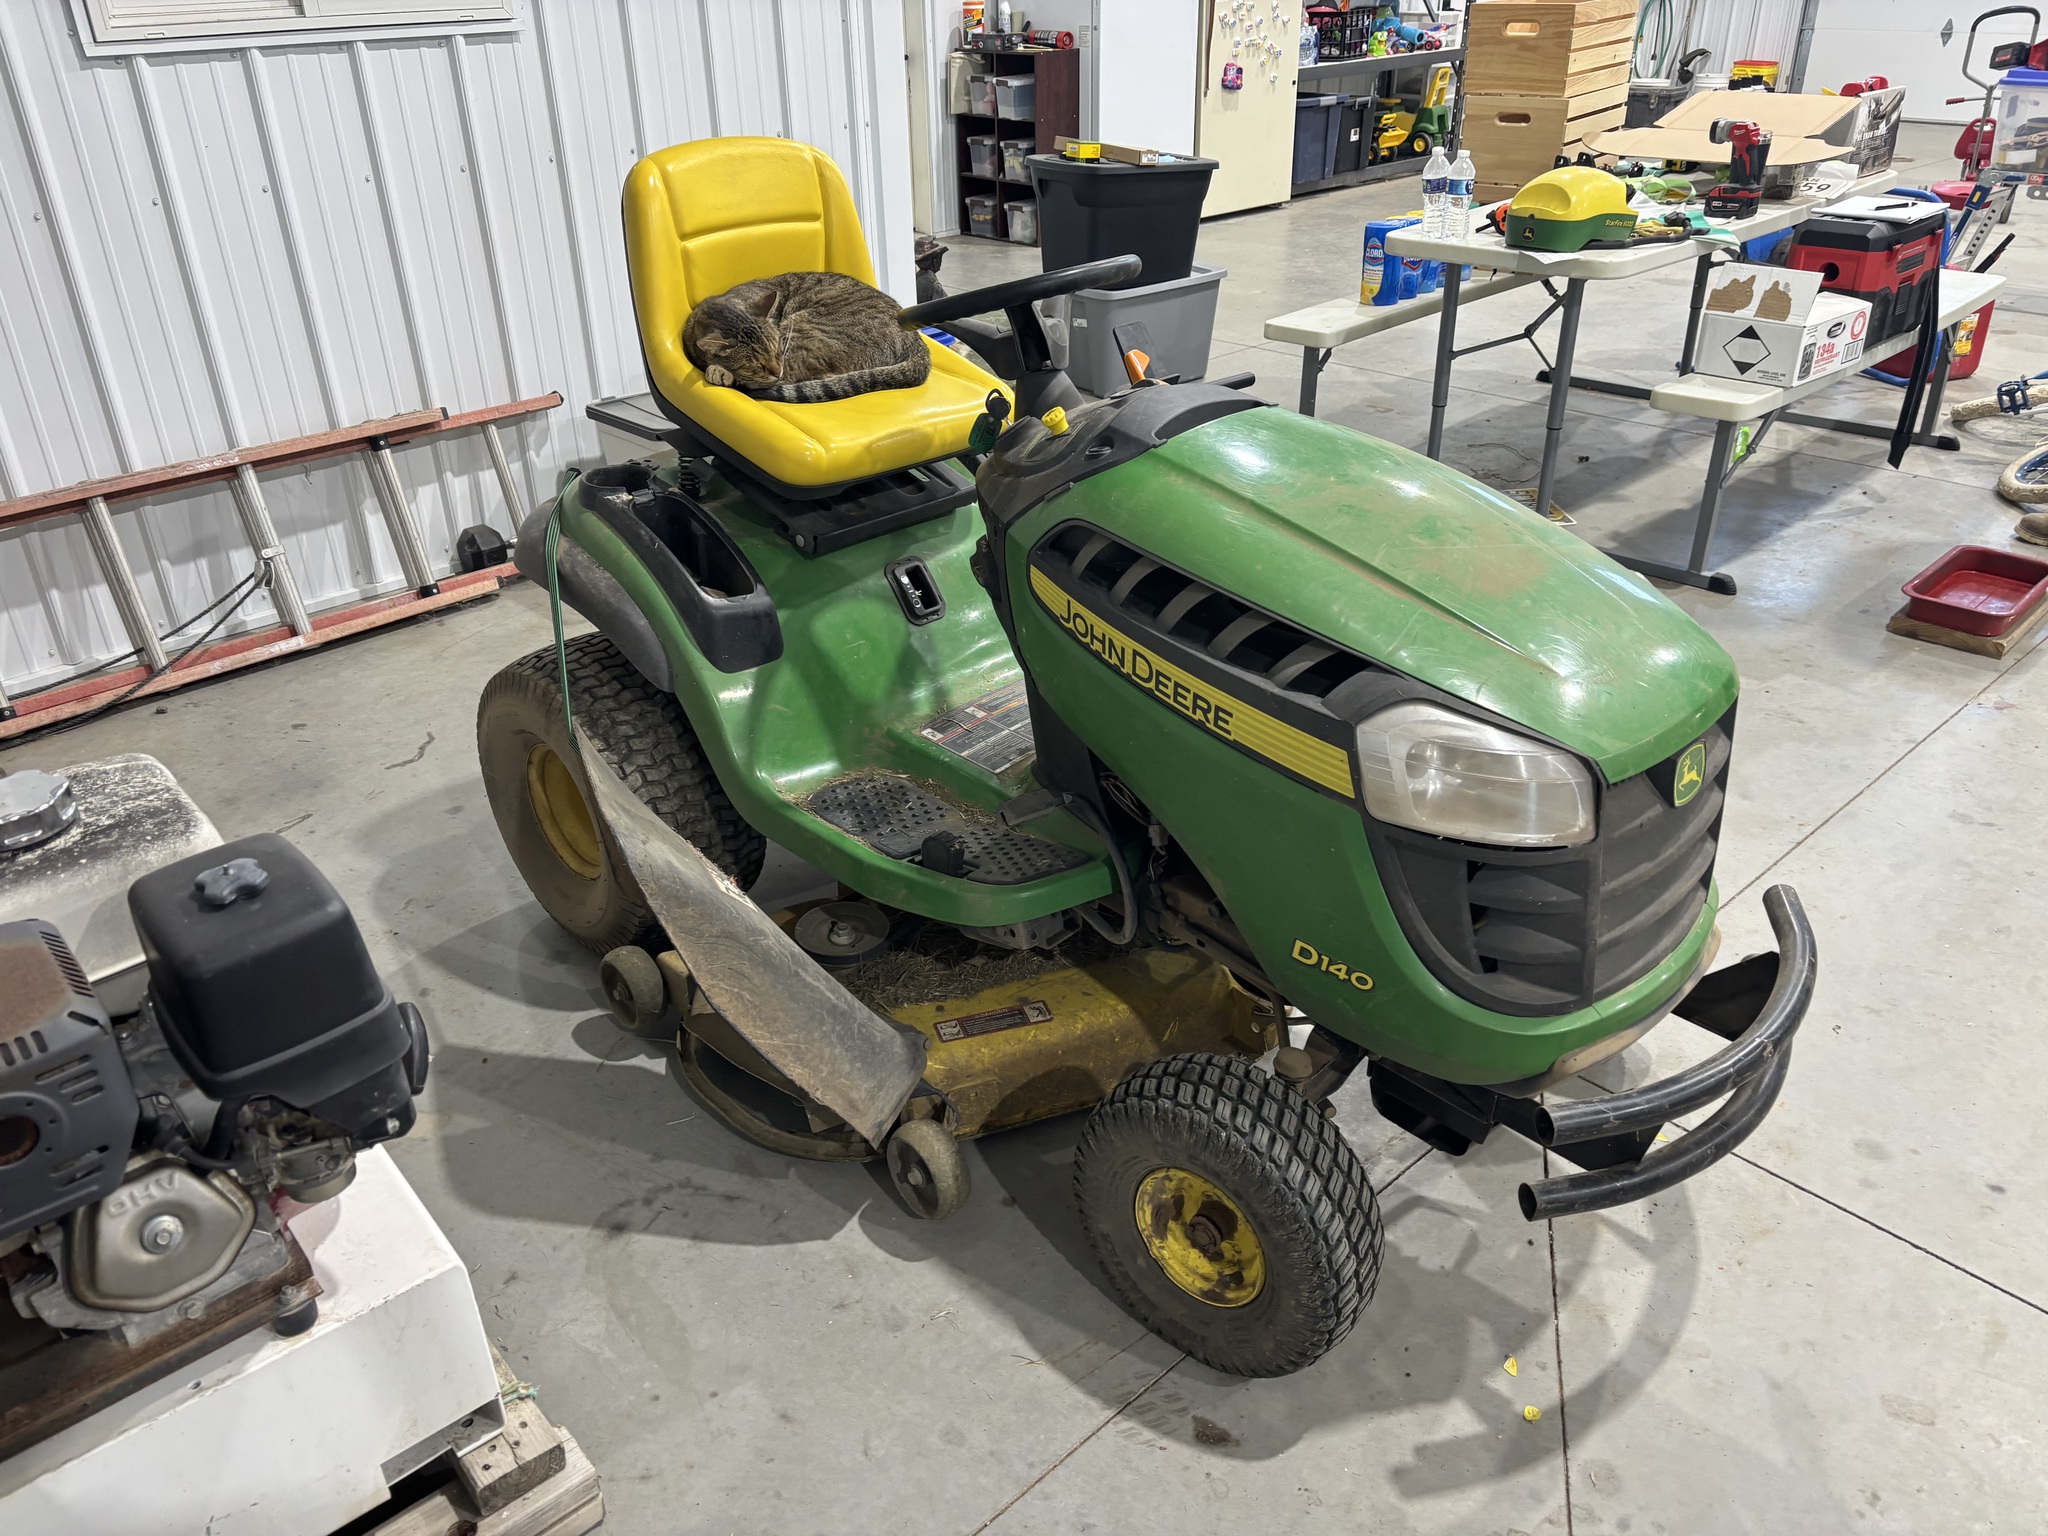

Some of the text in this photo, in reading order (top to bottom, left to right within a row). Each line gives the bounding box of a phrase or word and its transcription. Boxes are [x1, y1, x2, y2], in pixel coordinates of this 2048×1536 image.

[1366, 248, 1384, 258] CLORO
[1817, 342, 1835, 359] 134a
[1059, 598, 1234, 737] JOHN DEERE
[1290, 938, 1375, 992] D140
[979, 1008, 1008, 1017] DANGER
